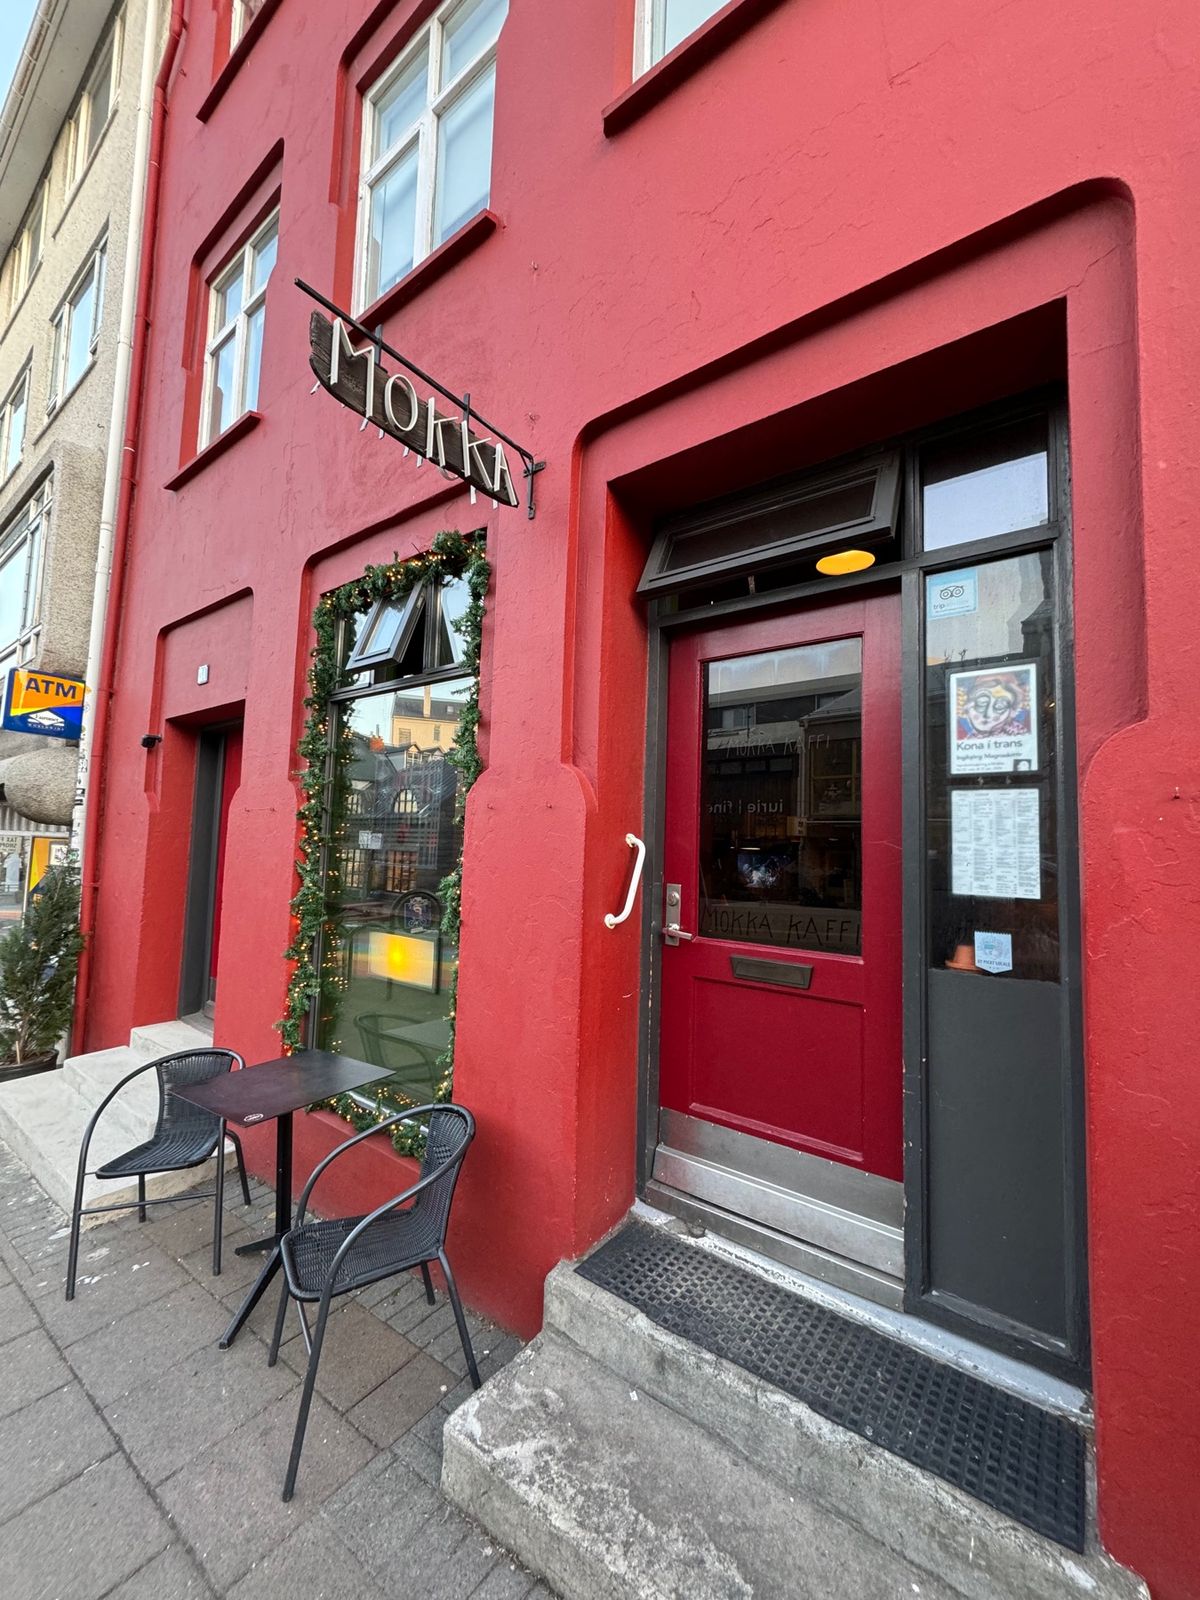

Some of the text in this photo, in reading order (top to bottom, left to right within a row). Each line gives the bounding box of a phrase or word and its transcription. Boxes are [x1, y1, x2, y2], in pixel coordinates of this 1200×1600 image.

[330, 317, 518, 506] MOKKA
[26, 677, 77, 699] ATM
[726, 733, 830, 758] MOKKA KAFFI
[956, 742, 984, 751] Kona
[994, 740, 1023, 749] trans
[701, 903, 860, 946] MOKKA KAFFI
